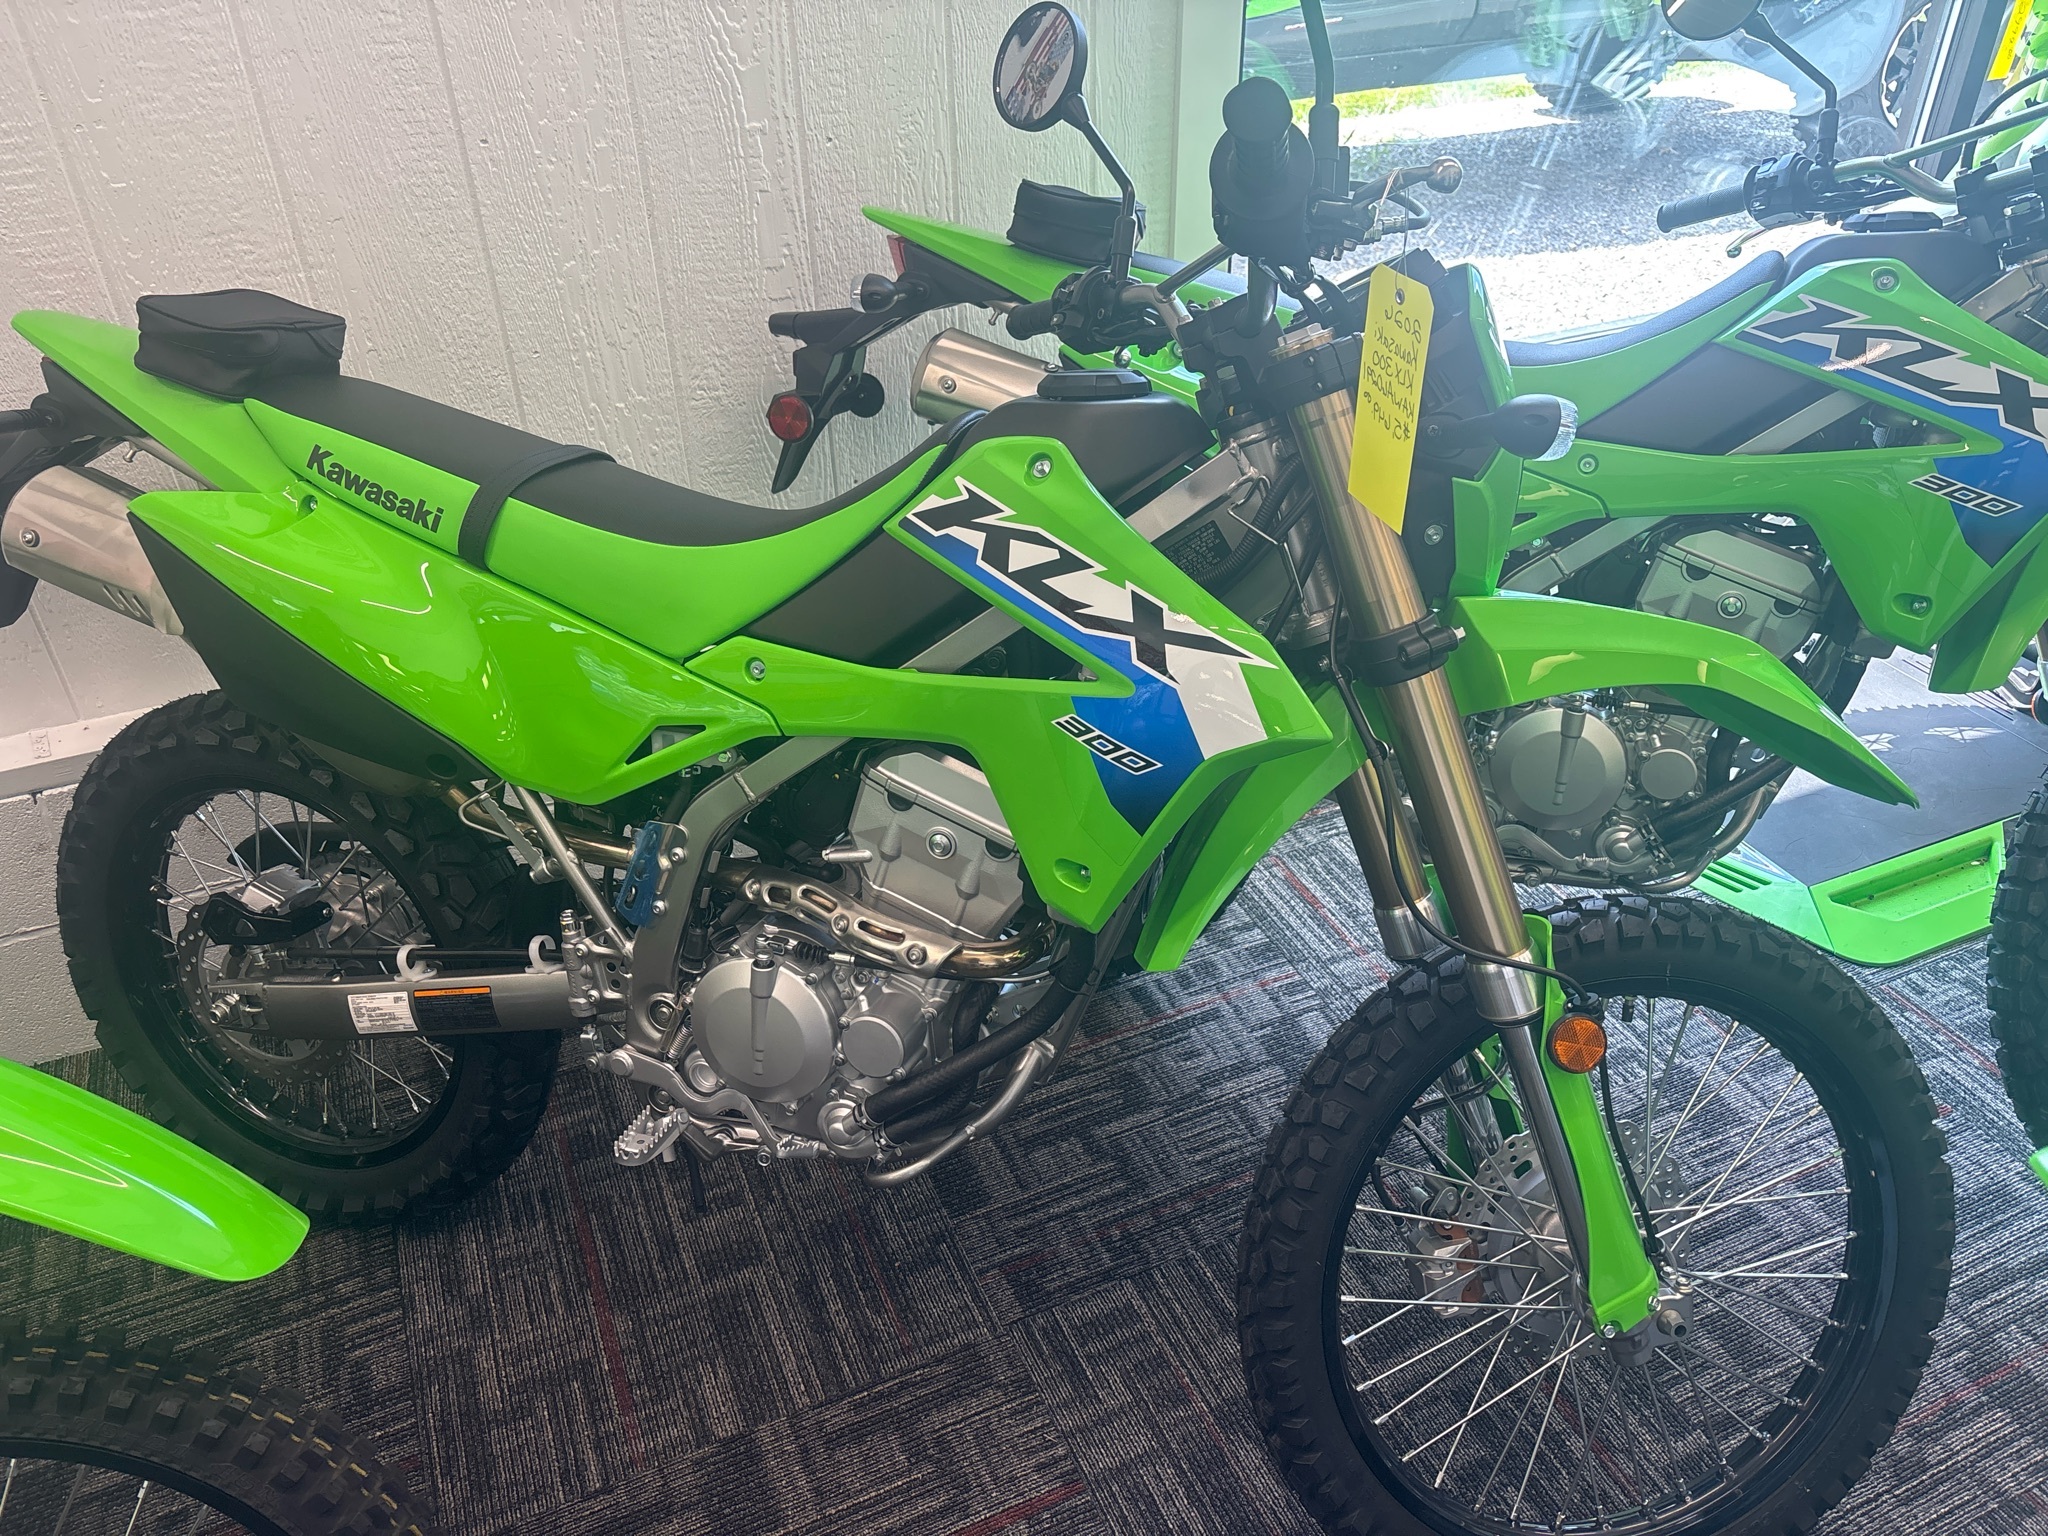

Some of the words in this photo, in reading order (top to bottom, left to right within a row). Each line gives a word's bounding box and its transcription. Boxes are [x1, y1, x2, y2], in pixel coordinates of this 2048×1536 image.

[306, 443, 445, 534] Kawasaki
[1910, 473, 2022, 516] 300
[908, 480, 1262, 687] KLX
[1053, 715, 1161, 774] 300
